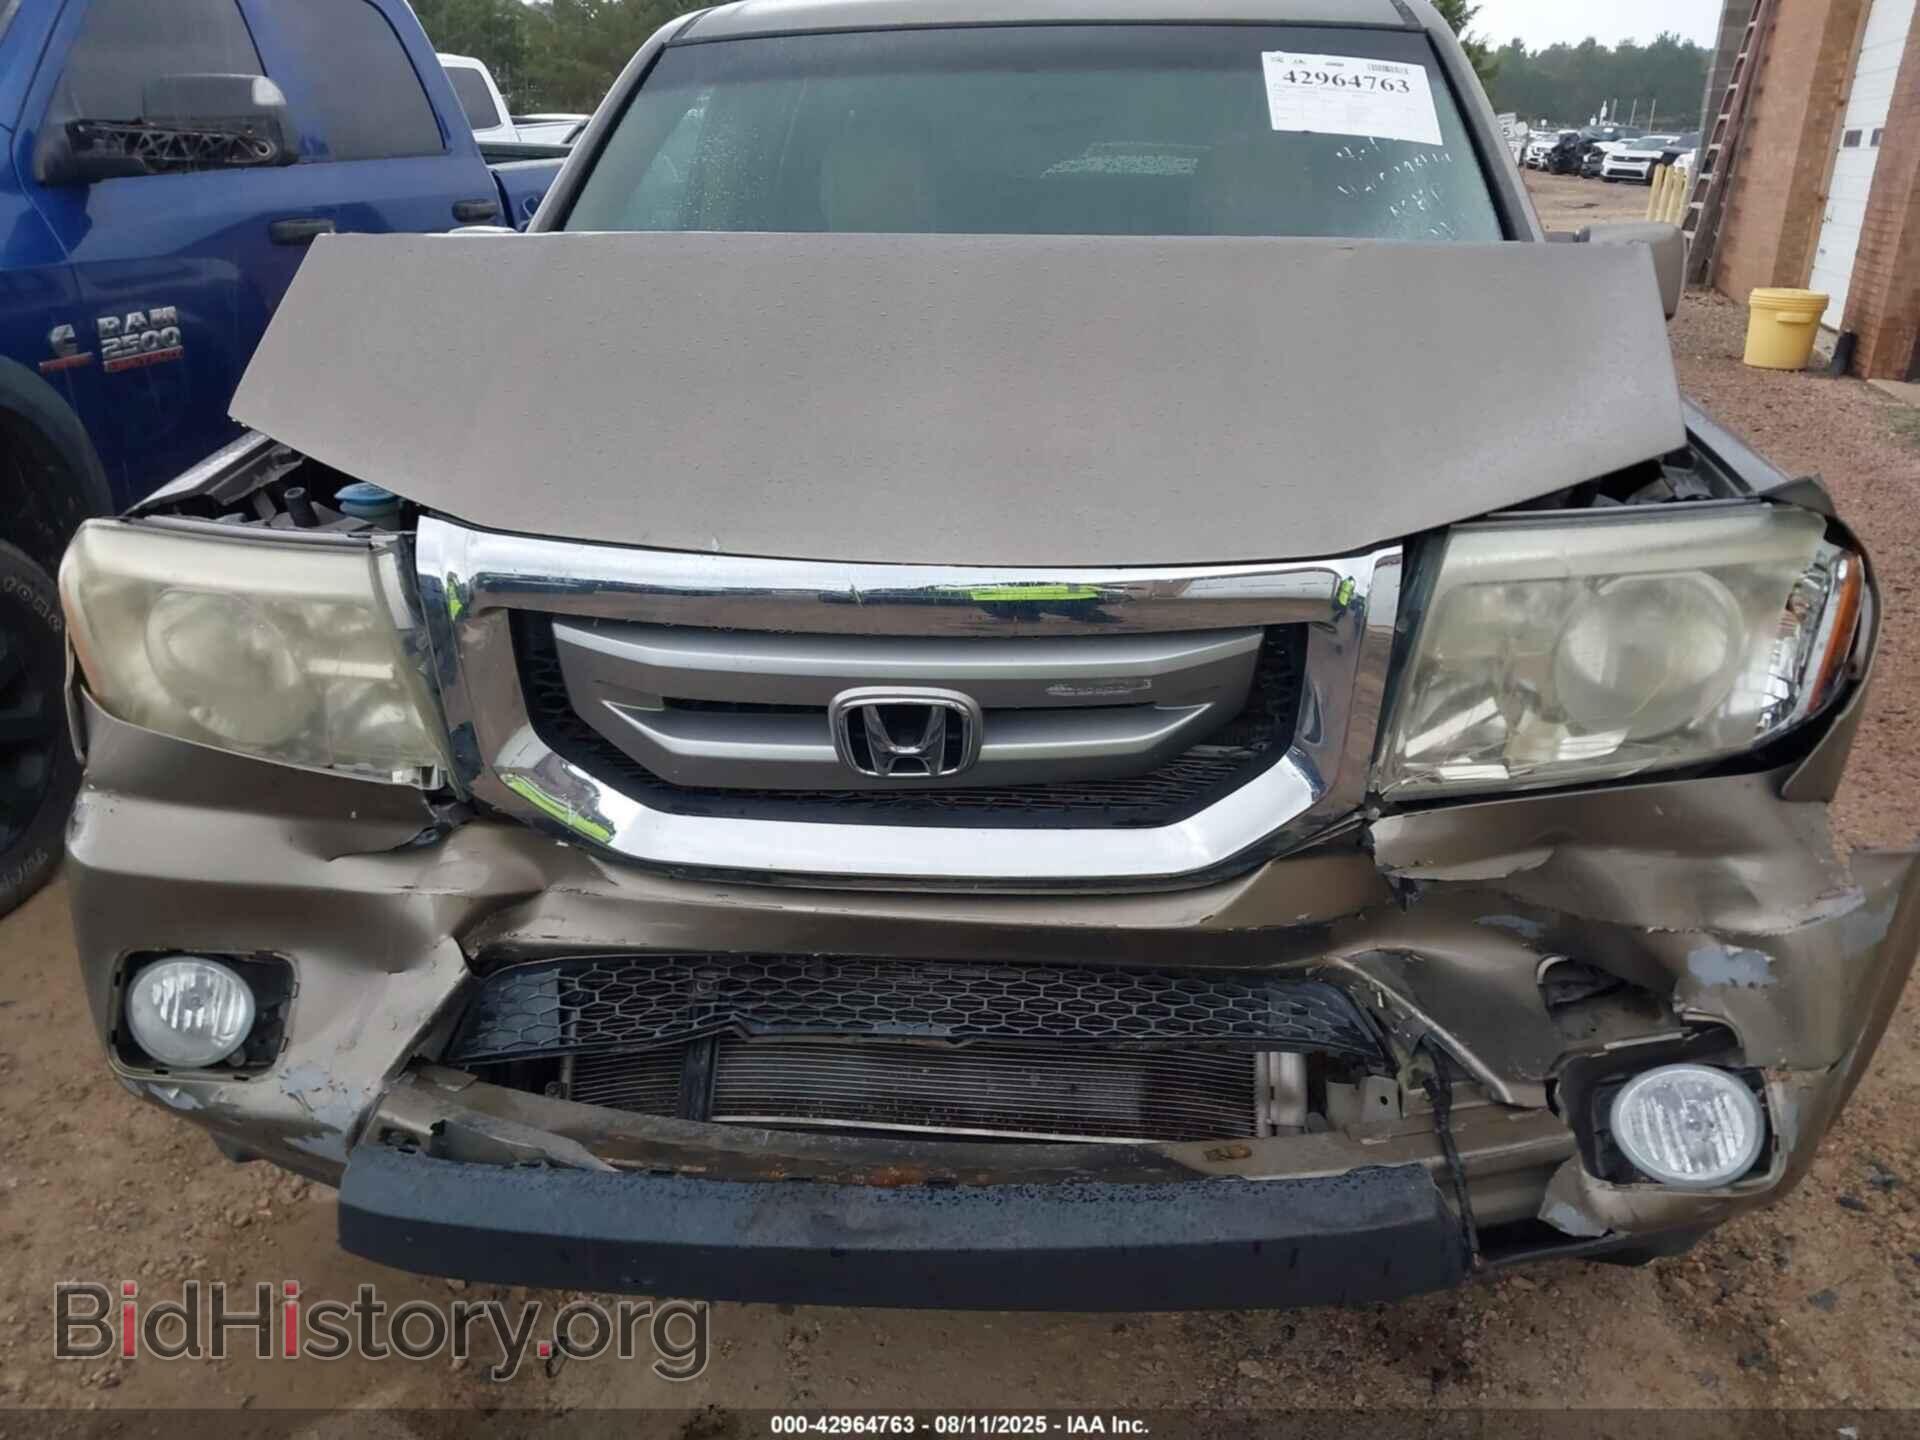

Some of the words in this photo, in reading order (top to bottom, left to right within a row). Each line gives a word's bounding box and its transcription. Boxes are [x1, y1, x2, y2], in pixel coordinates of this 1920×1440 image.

[1283, 69, 1410, 93] 42964763
[97, 306, 178, 338] RAM
[101, 327, 182, 360] 2500
